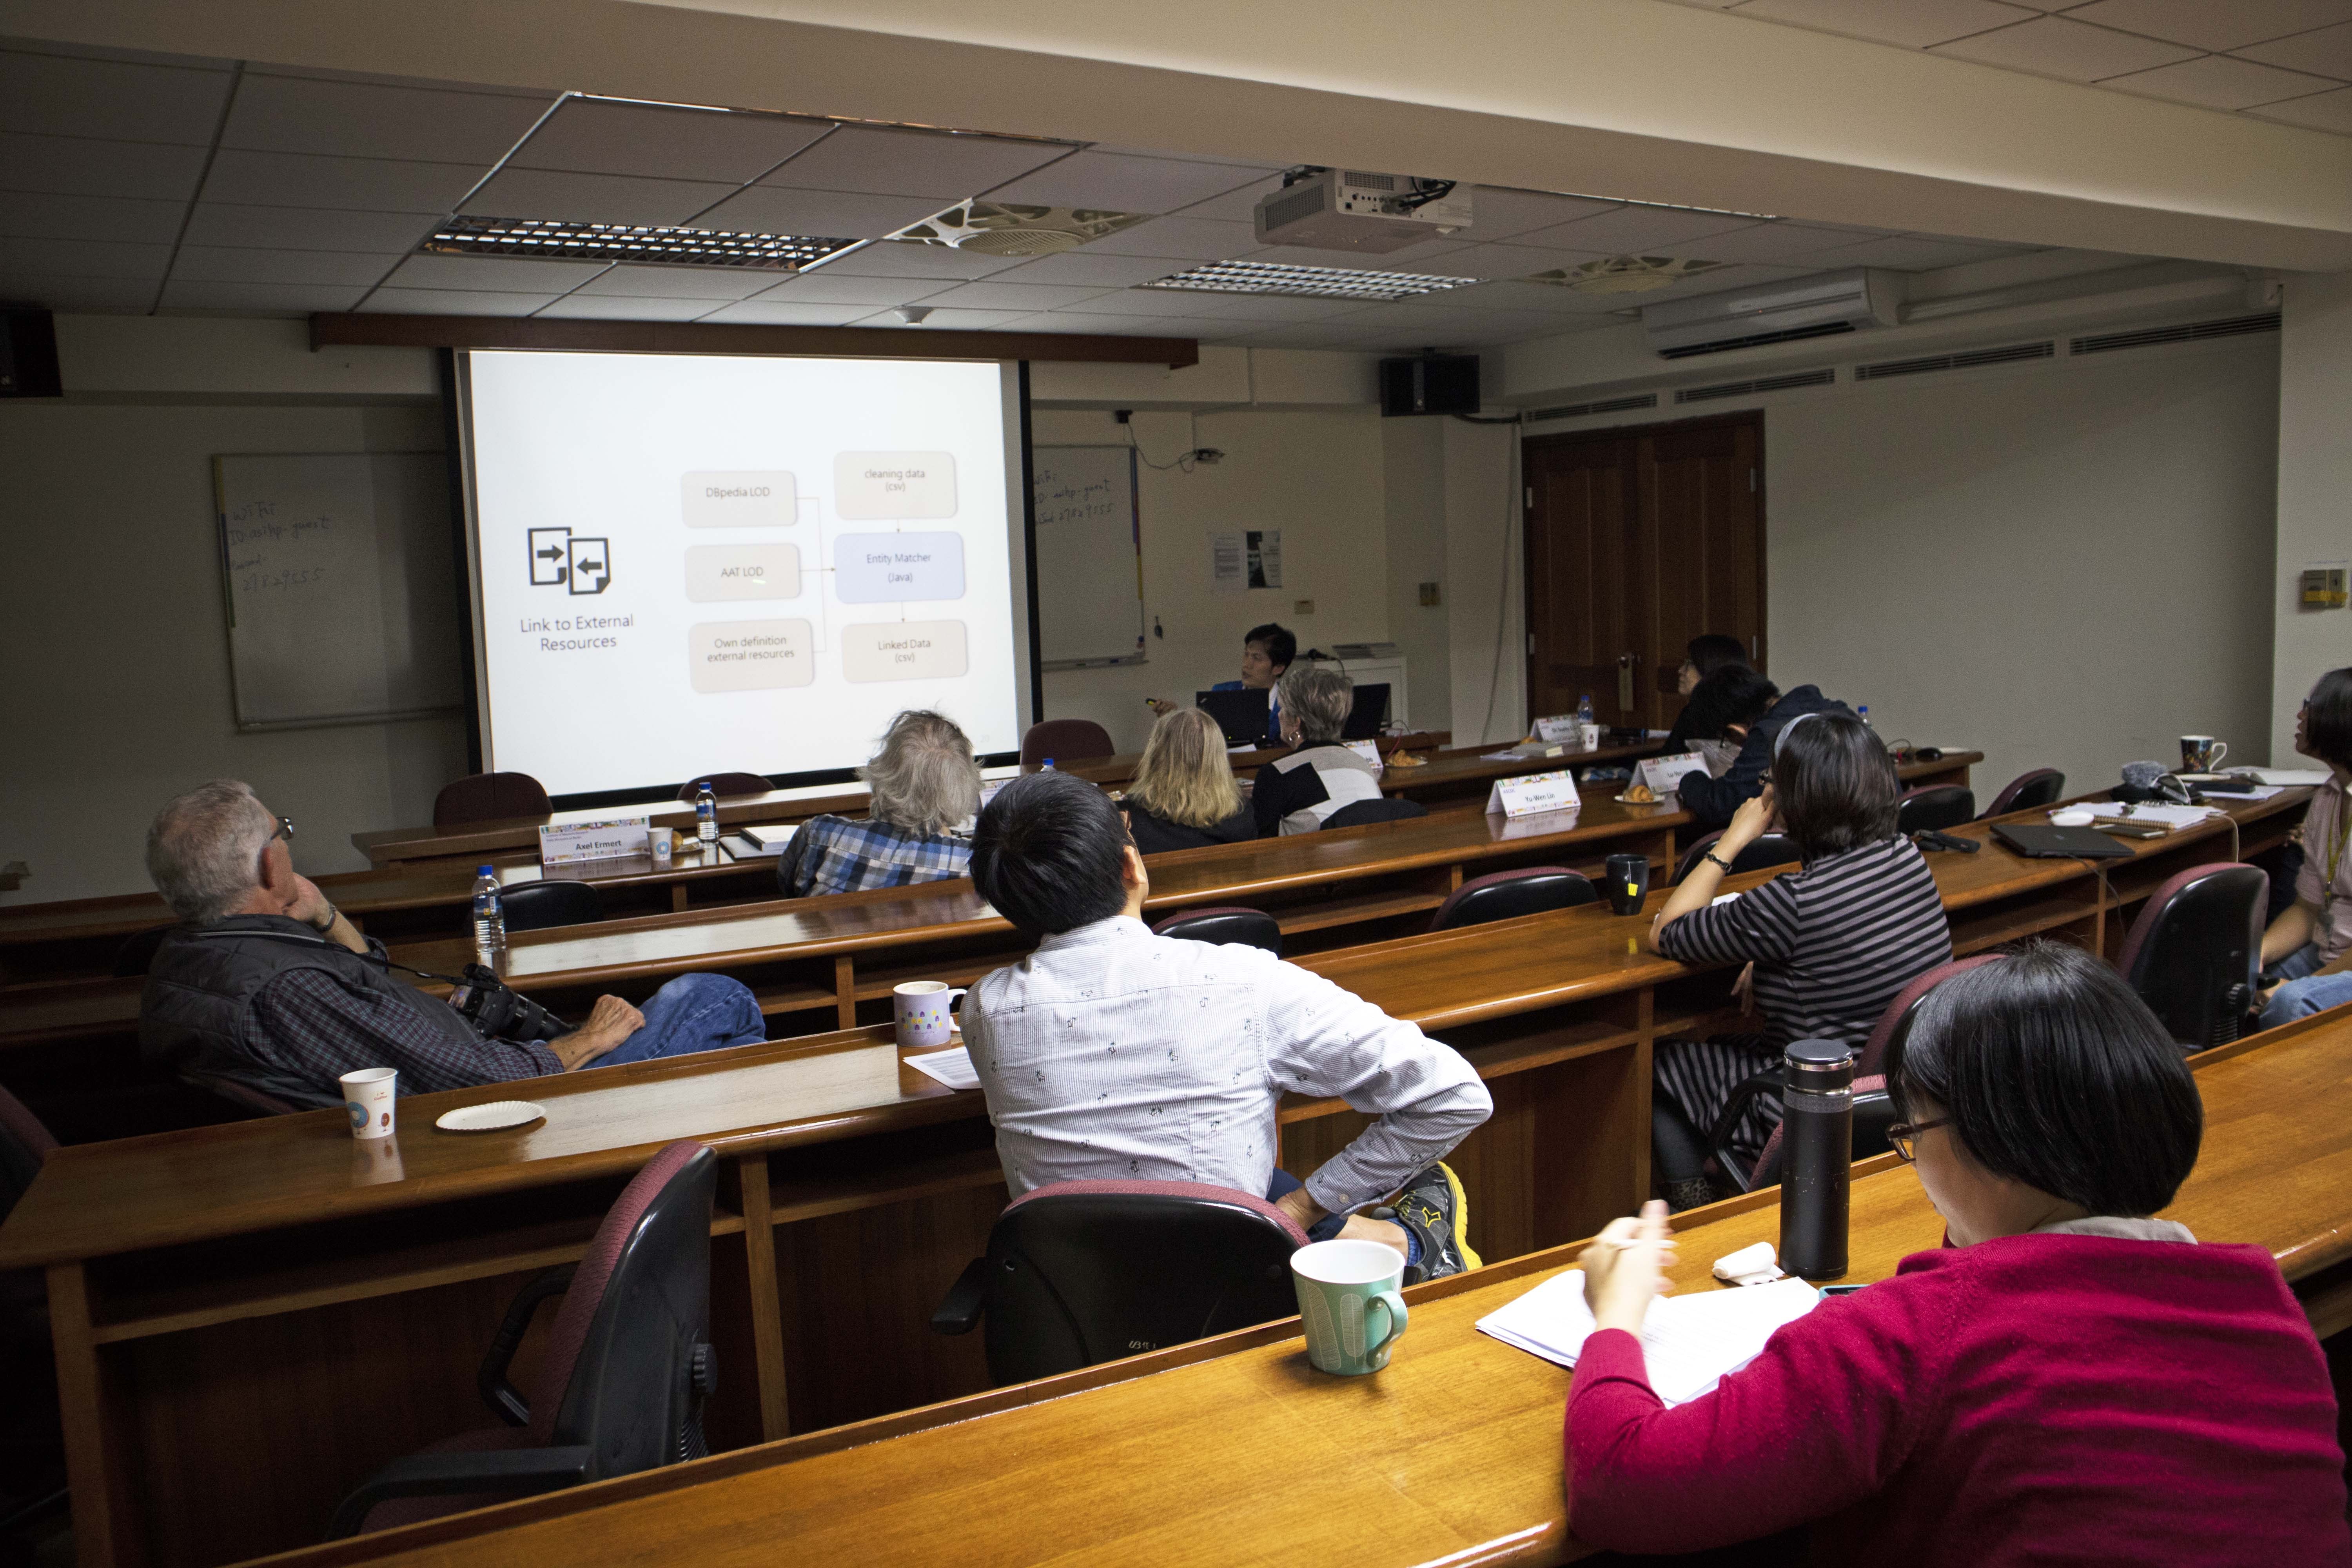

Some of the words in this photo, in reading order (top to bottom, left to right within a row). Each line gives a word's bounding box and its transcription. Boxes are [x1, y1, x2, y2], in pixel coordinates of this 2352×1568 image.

[864, 469, 903, 481] cleaning
[905, 469, 926, 479] data
[885, 481, 906, 492] (csv)
[706, 487, 747, 499] DBpedia
[750, 487, 770, 497] LOD
[866, 554, 892, 565] Entity
[895, 553, 931, 563] Matcher
[720, 567, 740, 577] AAT
[743, 566, 764, 577] LOD
[887, 572, 913, 583] (Java)
[521, 619, 550, 633] Link
[555, 619, 571, 631] to
[576, 613, 634, 630] External
[541, 637, 617, 652] Resources
[714, 638, 738, 648] Own
[740, 635, 787, 647] definition
[878, 639, 907, 651] Linked
[910, 639, 931, 649] Data
[707, 651, 746, 662] external
[748, 649, 795, 660] resources
[895, 652, 915, 663] (csv)
[1524, 794, 1546, 802] Yu-Wen
[575, 842, 593, 850] Axel
[594, 840, 622, 848] Ermert
